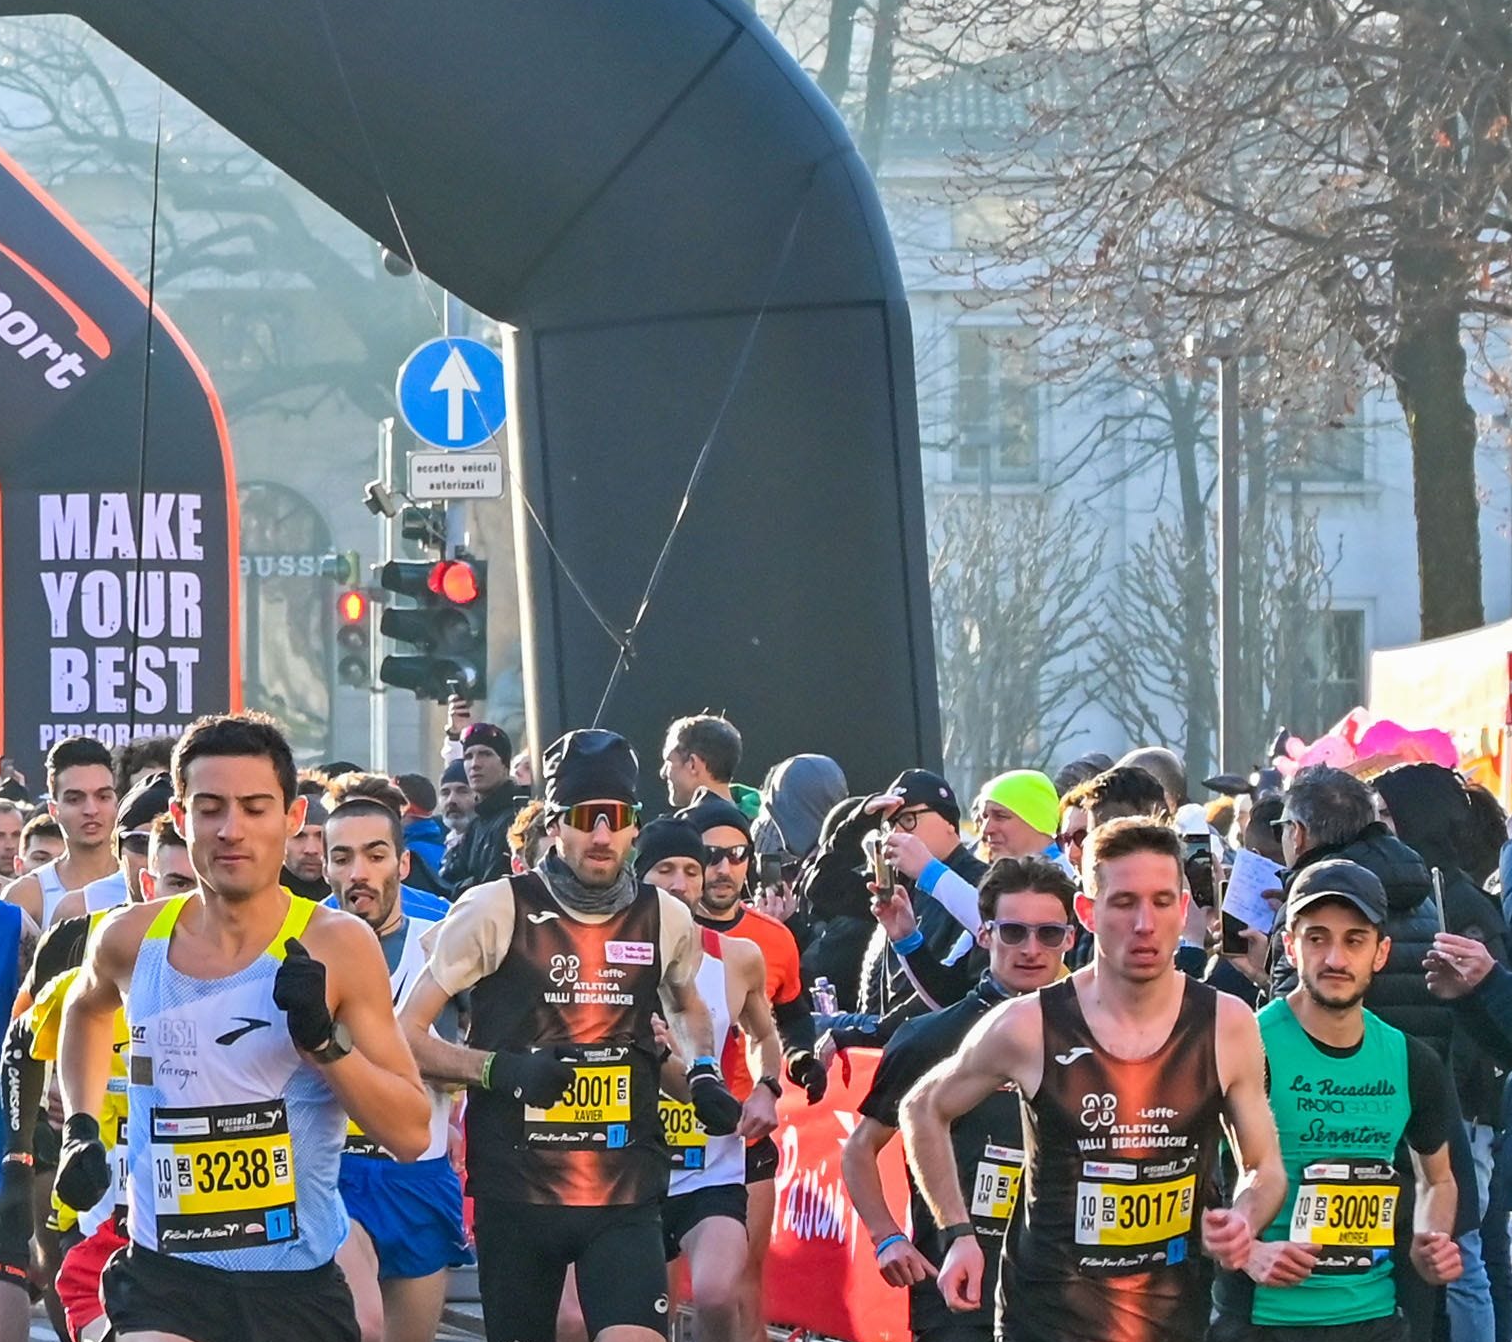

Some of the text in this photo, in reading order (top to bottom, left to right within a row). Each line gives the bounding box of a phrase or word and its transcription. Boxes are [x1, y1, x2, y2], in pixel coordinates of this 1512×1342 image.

[416, 462, 497, 474] eccetto veicoli
[429, 479, 485, 490] autorizzati
[38, 492, 205, 561] MAKE
[38, 569, 204, 639] YOUR
[49, 645, 199, 714] BEST
[573, 981, 620, 992] ATLETICA
[544, 992, 570, 1003] VALLI
[563, 1075, 611, 1107] 3001
[574, 1110, 603, 1121] XAVIER
[1109, 1124, 1170, 1135] ATLETICA
[1300, 1117, 1392, 1144] Sensitive
[1077, 1136, 1189, 1152] VALLI BERGAMASCHE
[156, 1158, 172, 1182] 10
[195, 1148, 270, 1194] 3238
[157, 1183, 173, 1199] KM
[979, 1173, 993, 1192] 10
[1081, 1195, 1097, 1217] 10
[1119, 1190, 1179, 1230] 3017
[1298, 1196, 1311, 1216] 10
[1329, 1194, 1380, 1229] 3009
[1080, 1217, 1095, 1231] KM
[1338, 1232, 1369, 1245] ANDREA
